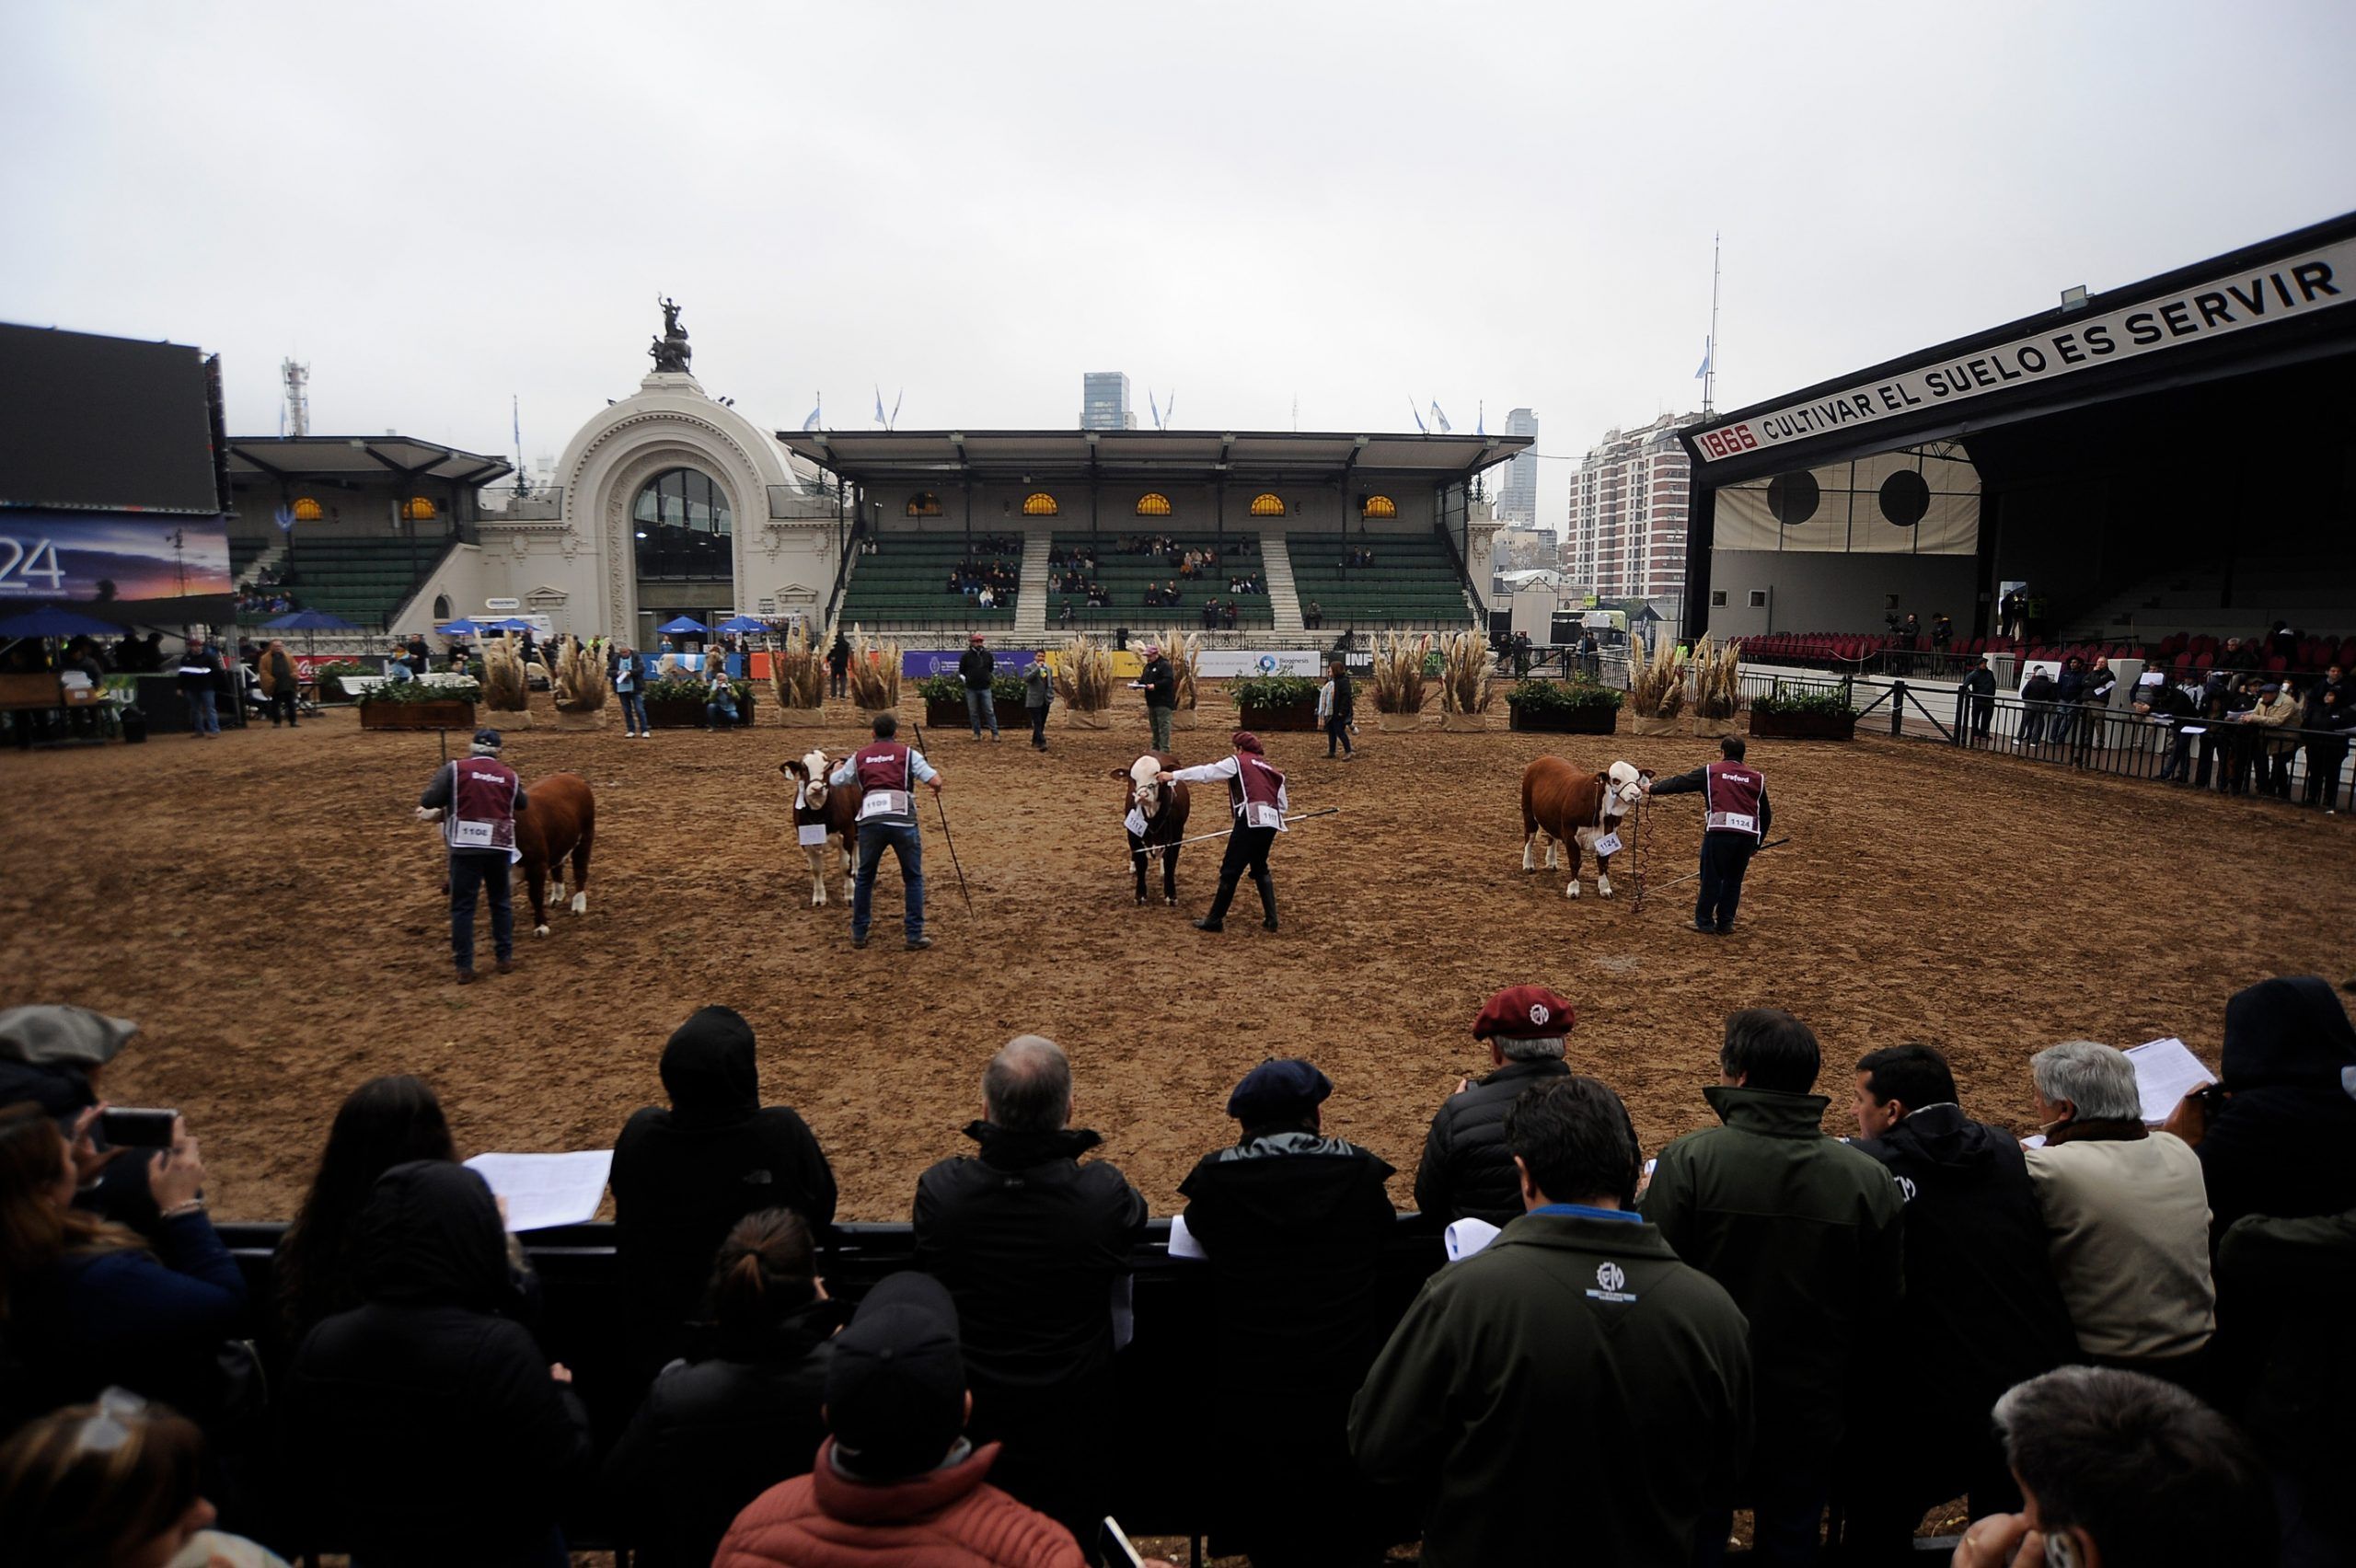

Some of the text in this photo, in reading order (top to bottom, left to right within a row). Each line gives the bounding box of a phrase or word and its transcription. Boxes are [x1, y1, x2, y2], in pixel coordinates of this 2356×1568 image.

[1699, 260, 2342, 460] 1866 CULTIVAR EL SUELO ES SERVIR
[1722, 773, 1750, 784] Braford
[1730, 818, 1750, 828] 1124
[1600, 836, 1616, 850] 1124
